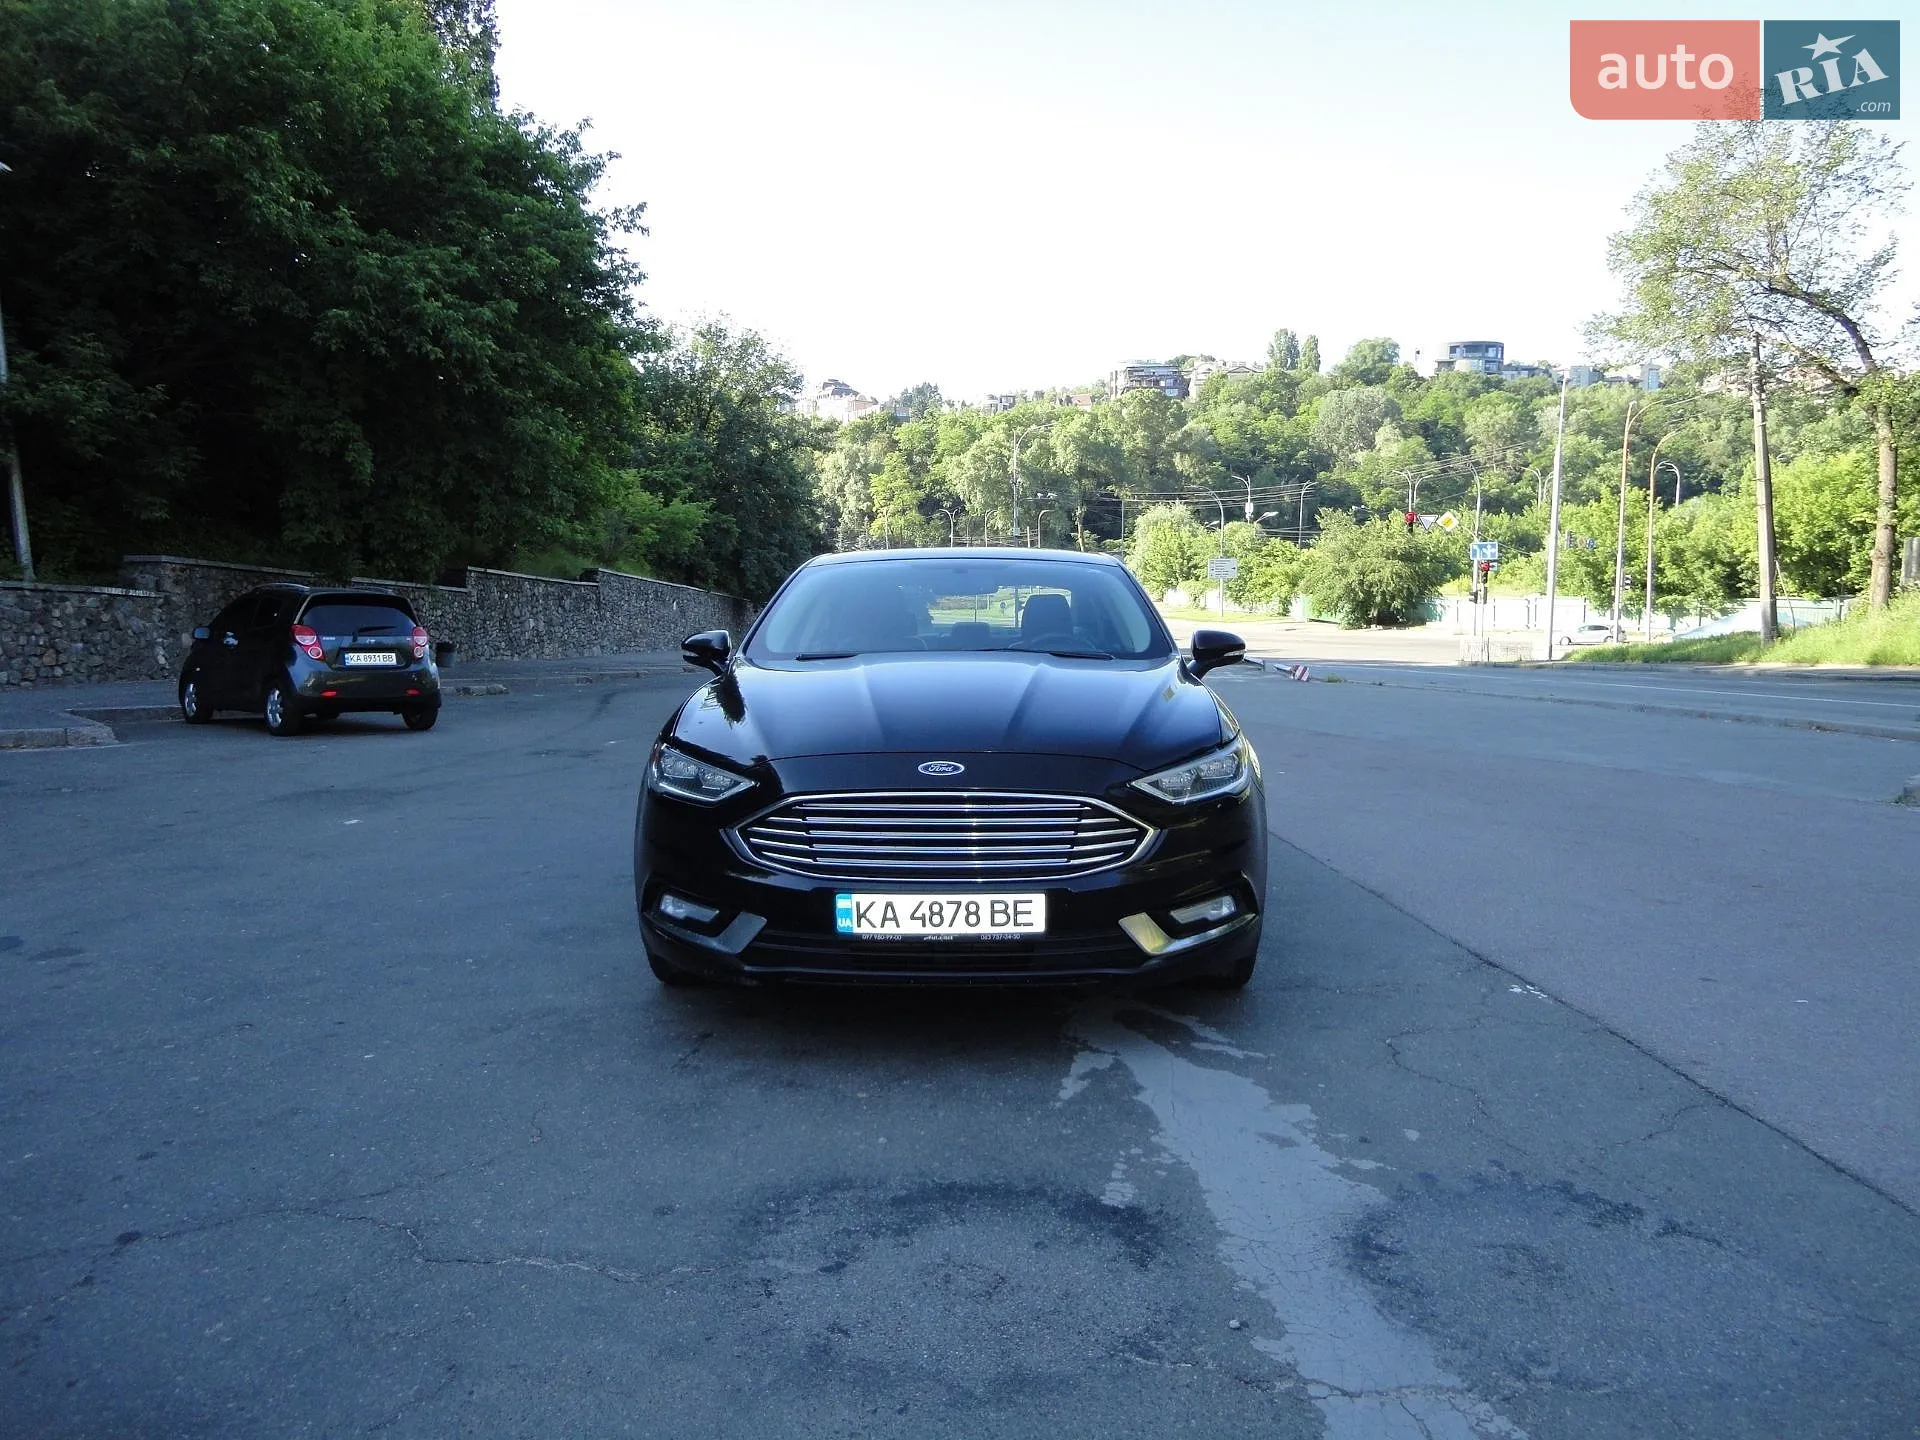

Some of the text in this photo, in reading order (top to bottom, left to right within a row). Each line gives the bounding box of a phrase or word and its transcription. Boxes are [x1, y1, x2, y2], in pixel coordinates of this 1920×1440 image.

[349, 654, 394, 663] KA 8931 BB
[928, 763, 954, 772] Ford
[855, 899, 1034, 929] KA 4878 BE
